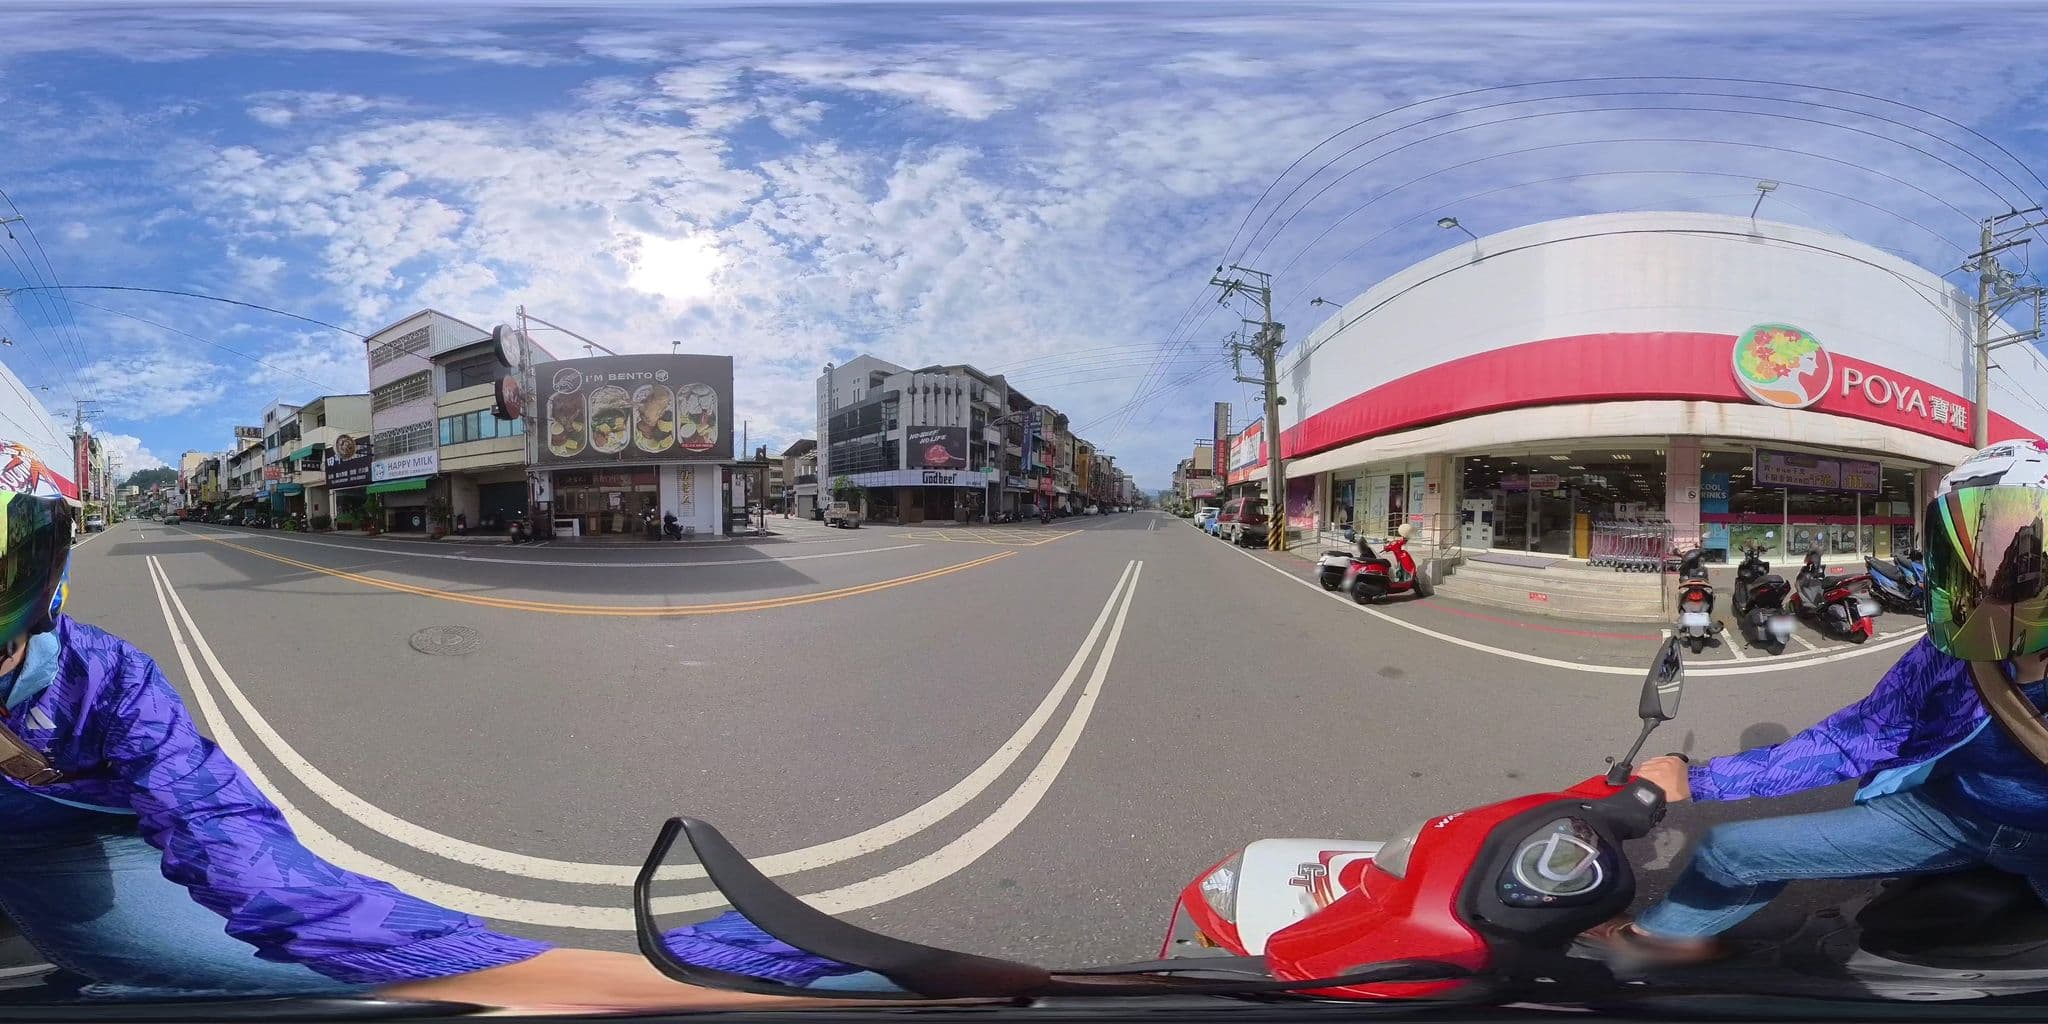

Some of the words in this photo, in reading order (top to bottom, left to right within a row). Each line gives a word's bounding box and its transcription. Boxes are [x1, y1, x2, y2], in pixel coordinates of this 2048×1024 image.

[585, 374, 603, 383] I'M
[608, 372, 653, 381] BENTO
[1841, 366, 1928, 419] POYA
[1929, 395, 1967, 432] 寶雅
[387, 459, 411, 471] HAPPY
[412, 456, 433, 467] MILK
[1701, 491, 1727, 499] RINKS
